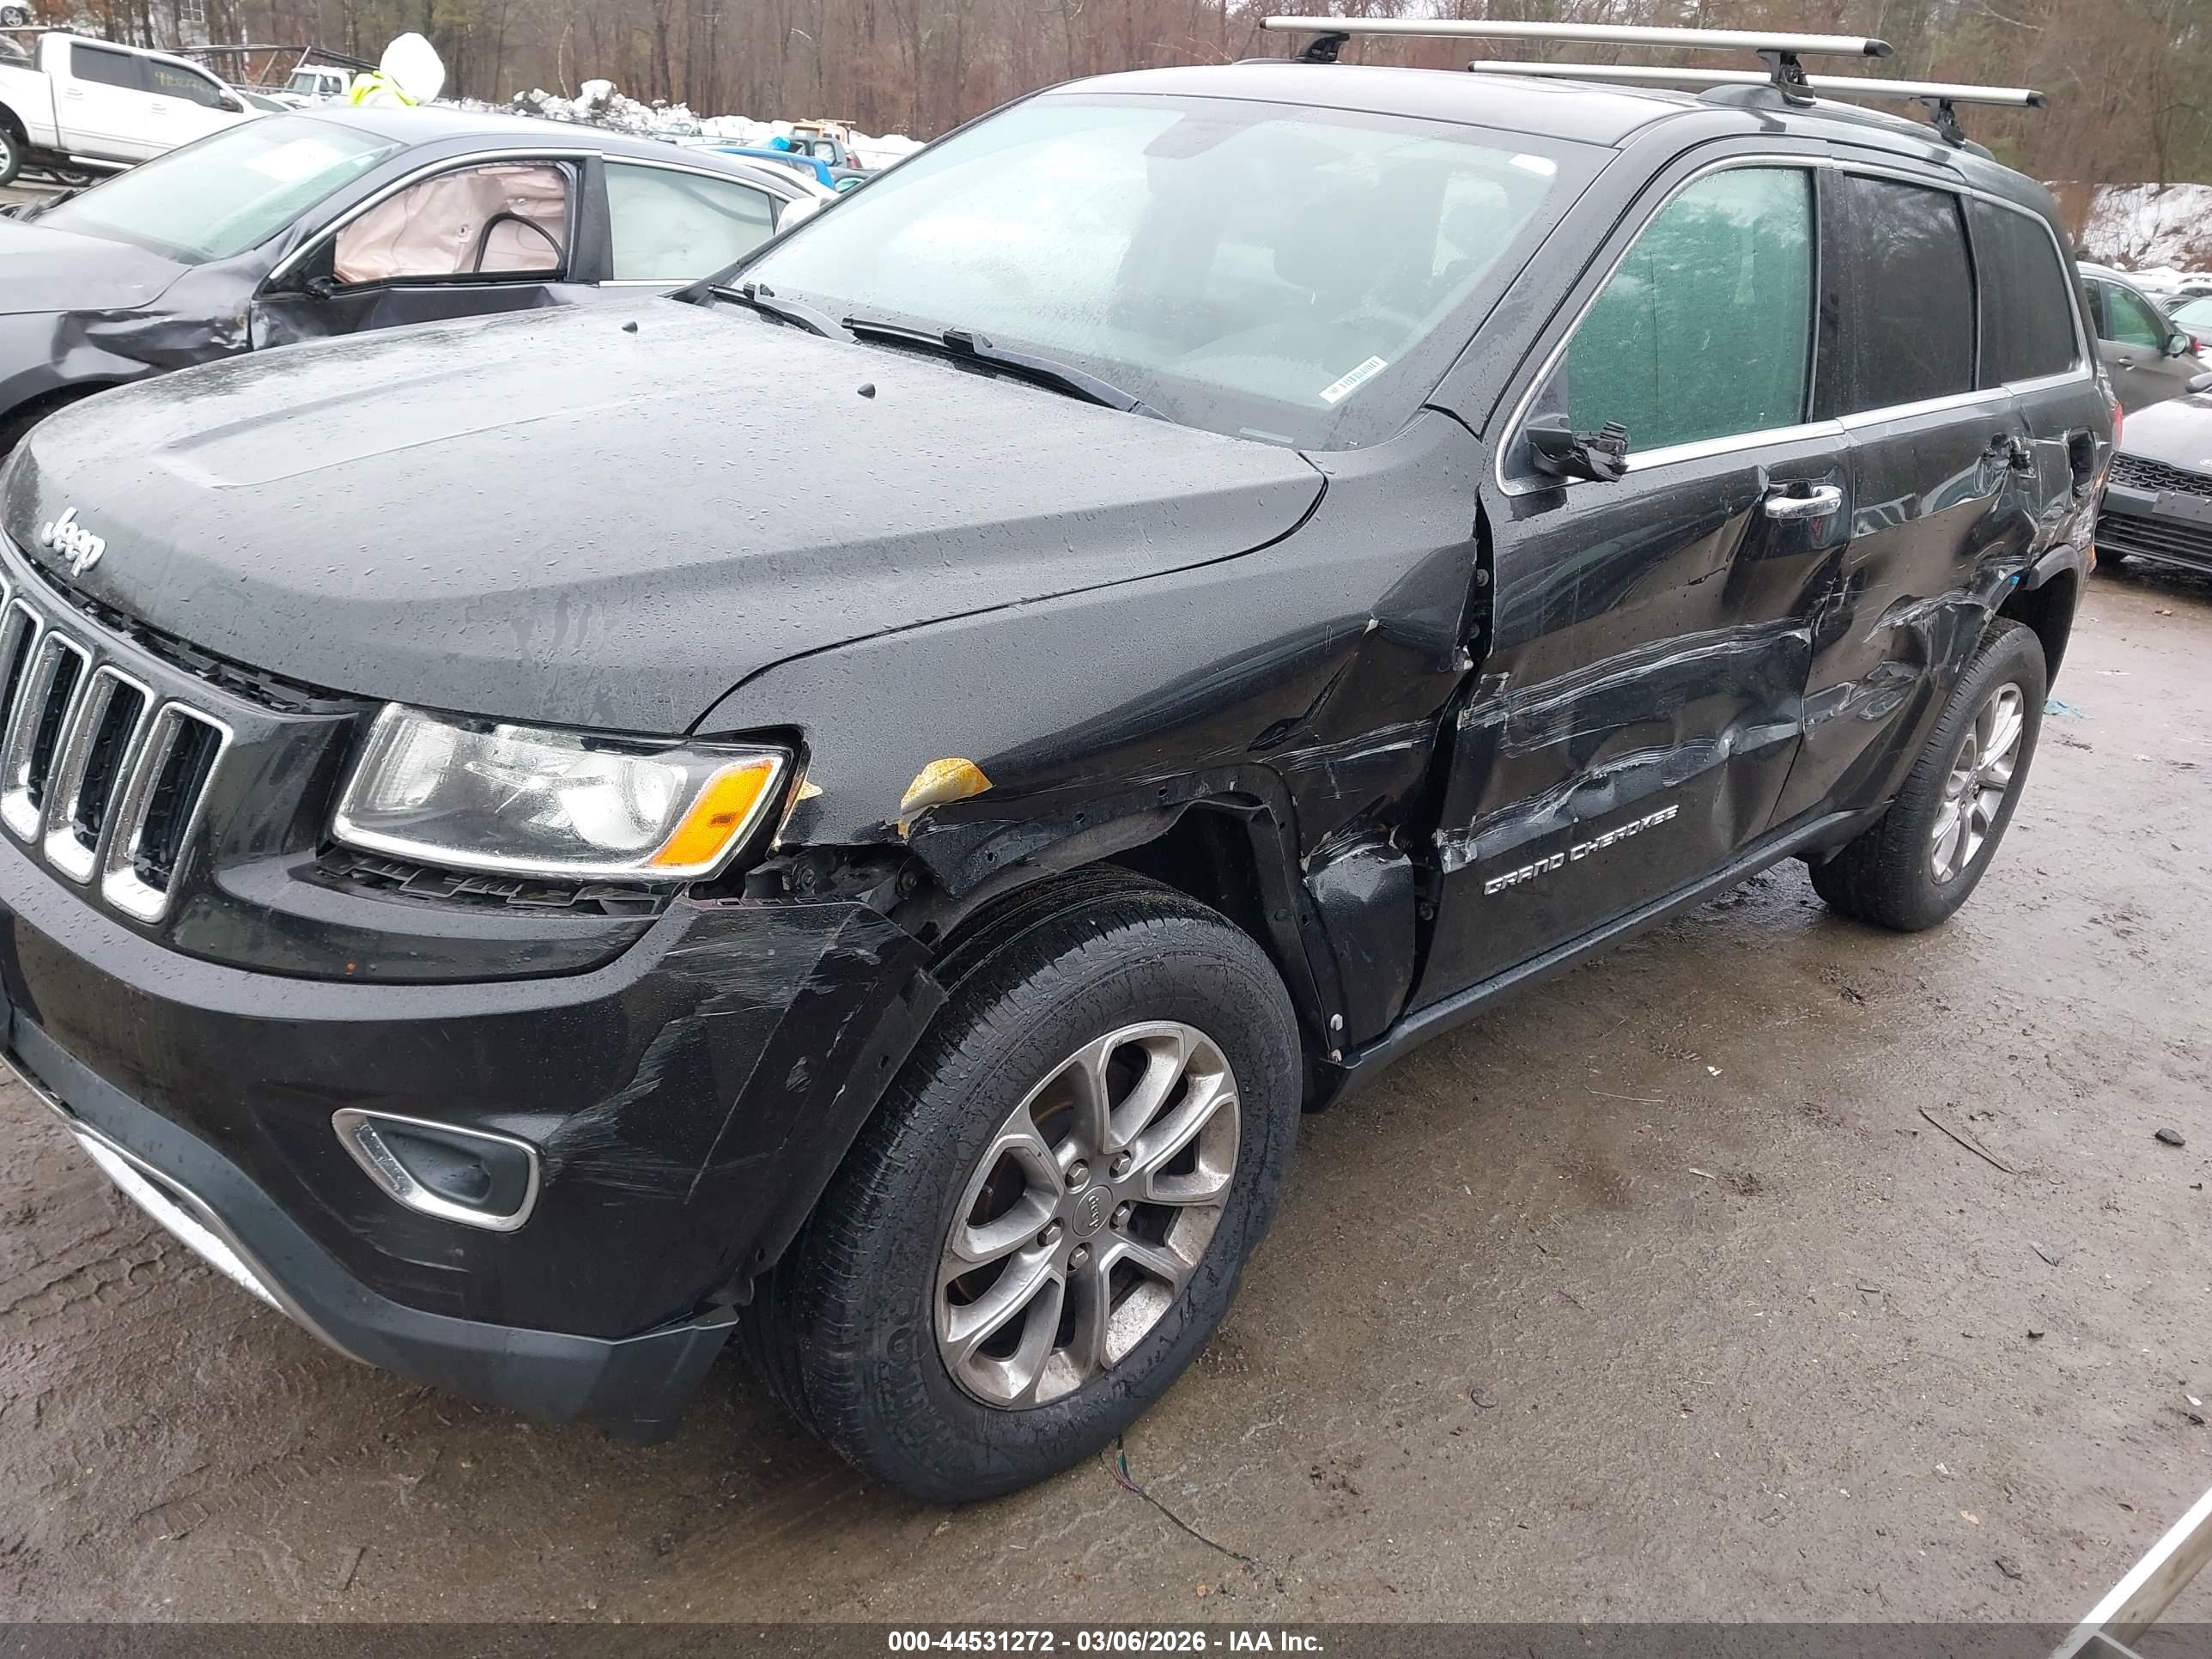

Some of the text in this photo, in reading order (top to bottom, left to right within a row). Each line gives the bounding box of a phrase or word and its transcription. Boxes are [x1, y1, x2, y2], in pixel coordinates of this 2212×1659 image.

[41, 507, 106, 578] Jeep
[1483, 804, 1680, 896] GRAND CHEROKEE
